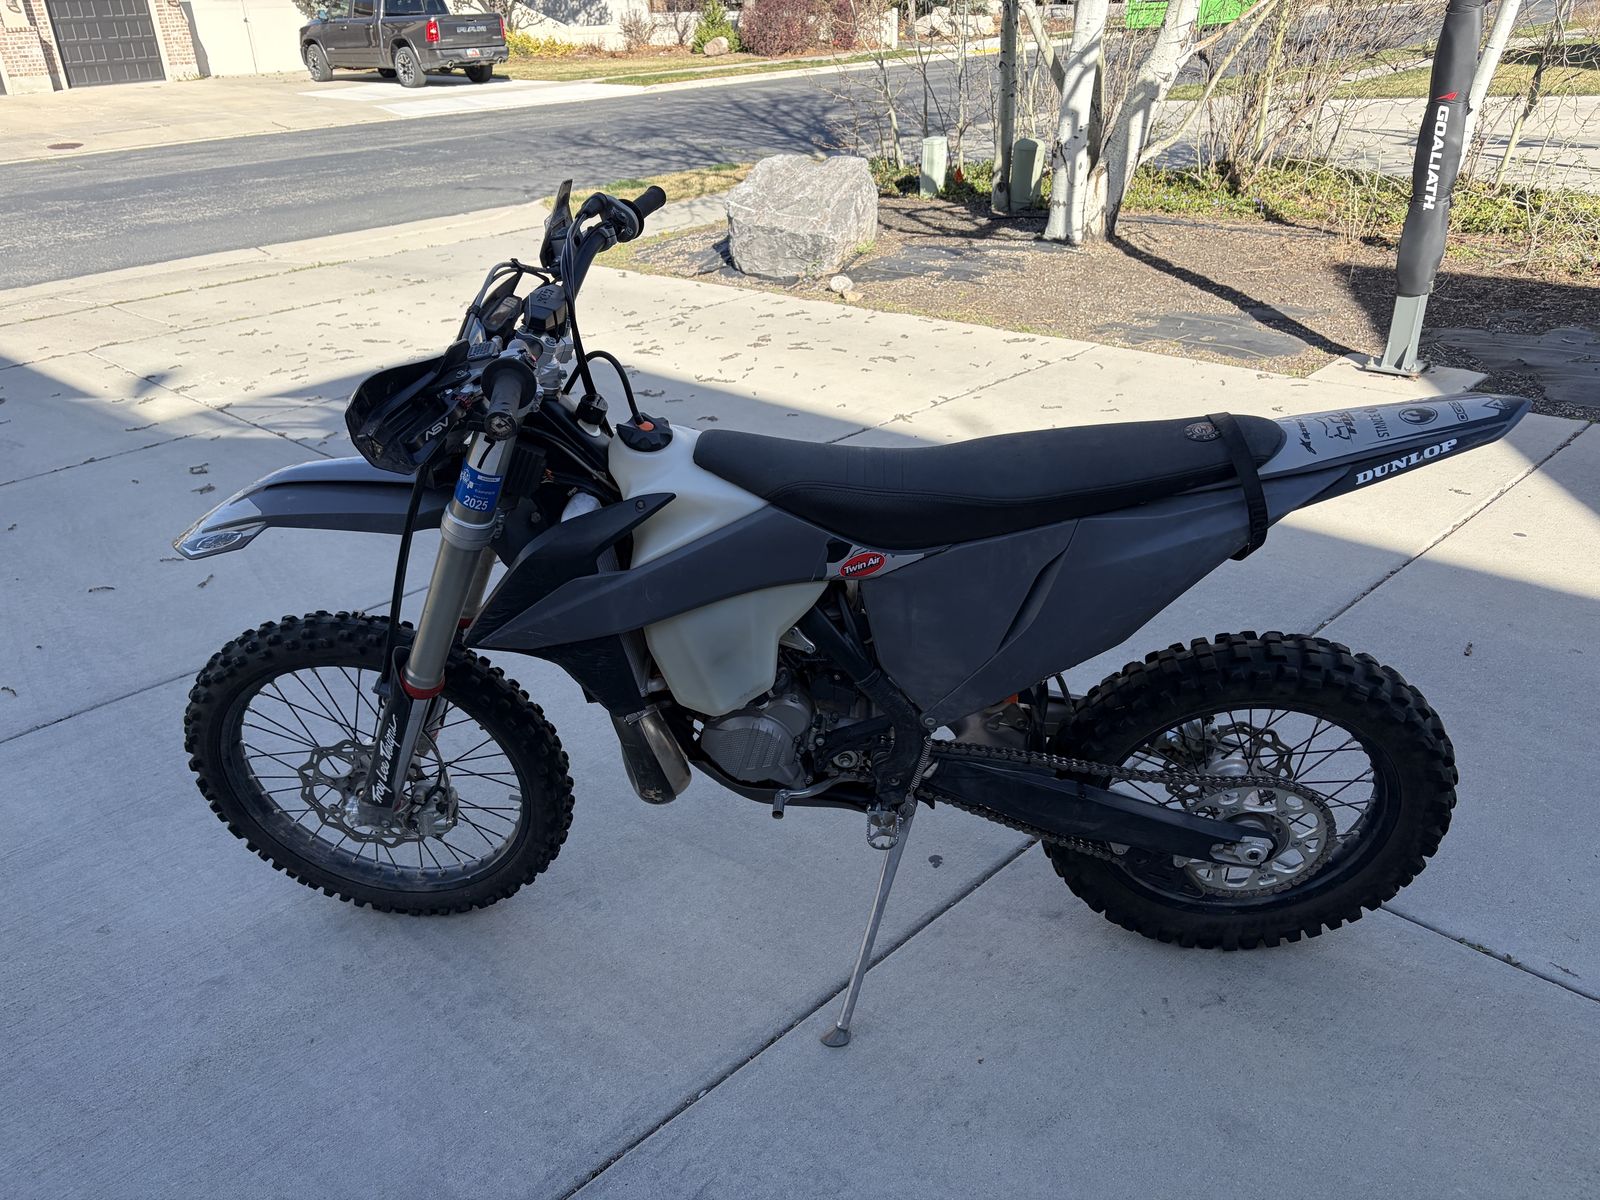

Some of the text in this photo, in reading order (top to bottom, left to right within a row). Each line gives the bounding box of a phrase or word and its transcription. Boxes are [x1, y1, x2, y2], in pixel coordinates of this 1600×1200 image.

[1423, 105, 1450, 210] GOALIATH
[1368, 413, 1390, 438] STANCE
[1355, 438, 1458, 485] DUNLOP
[463, 495, 489, 511] 2025
[843, 555, 881, 575] Twin Air
[371, 713, 401, 804] Troy Lee Designs
